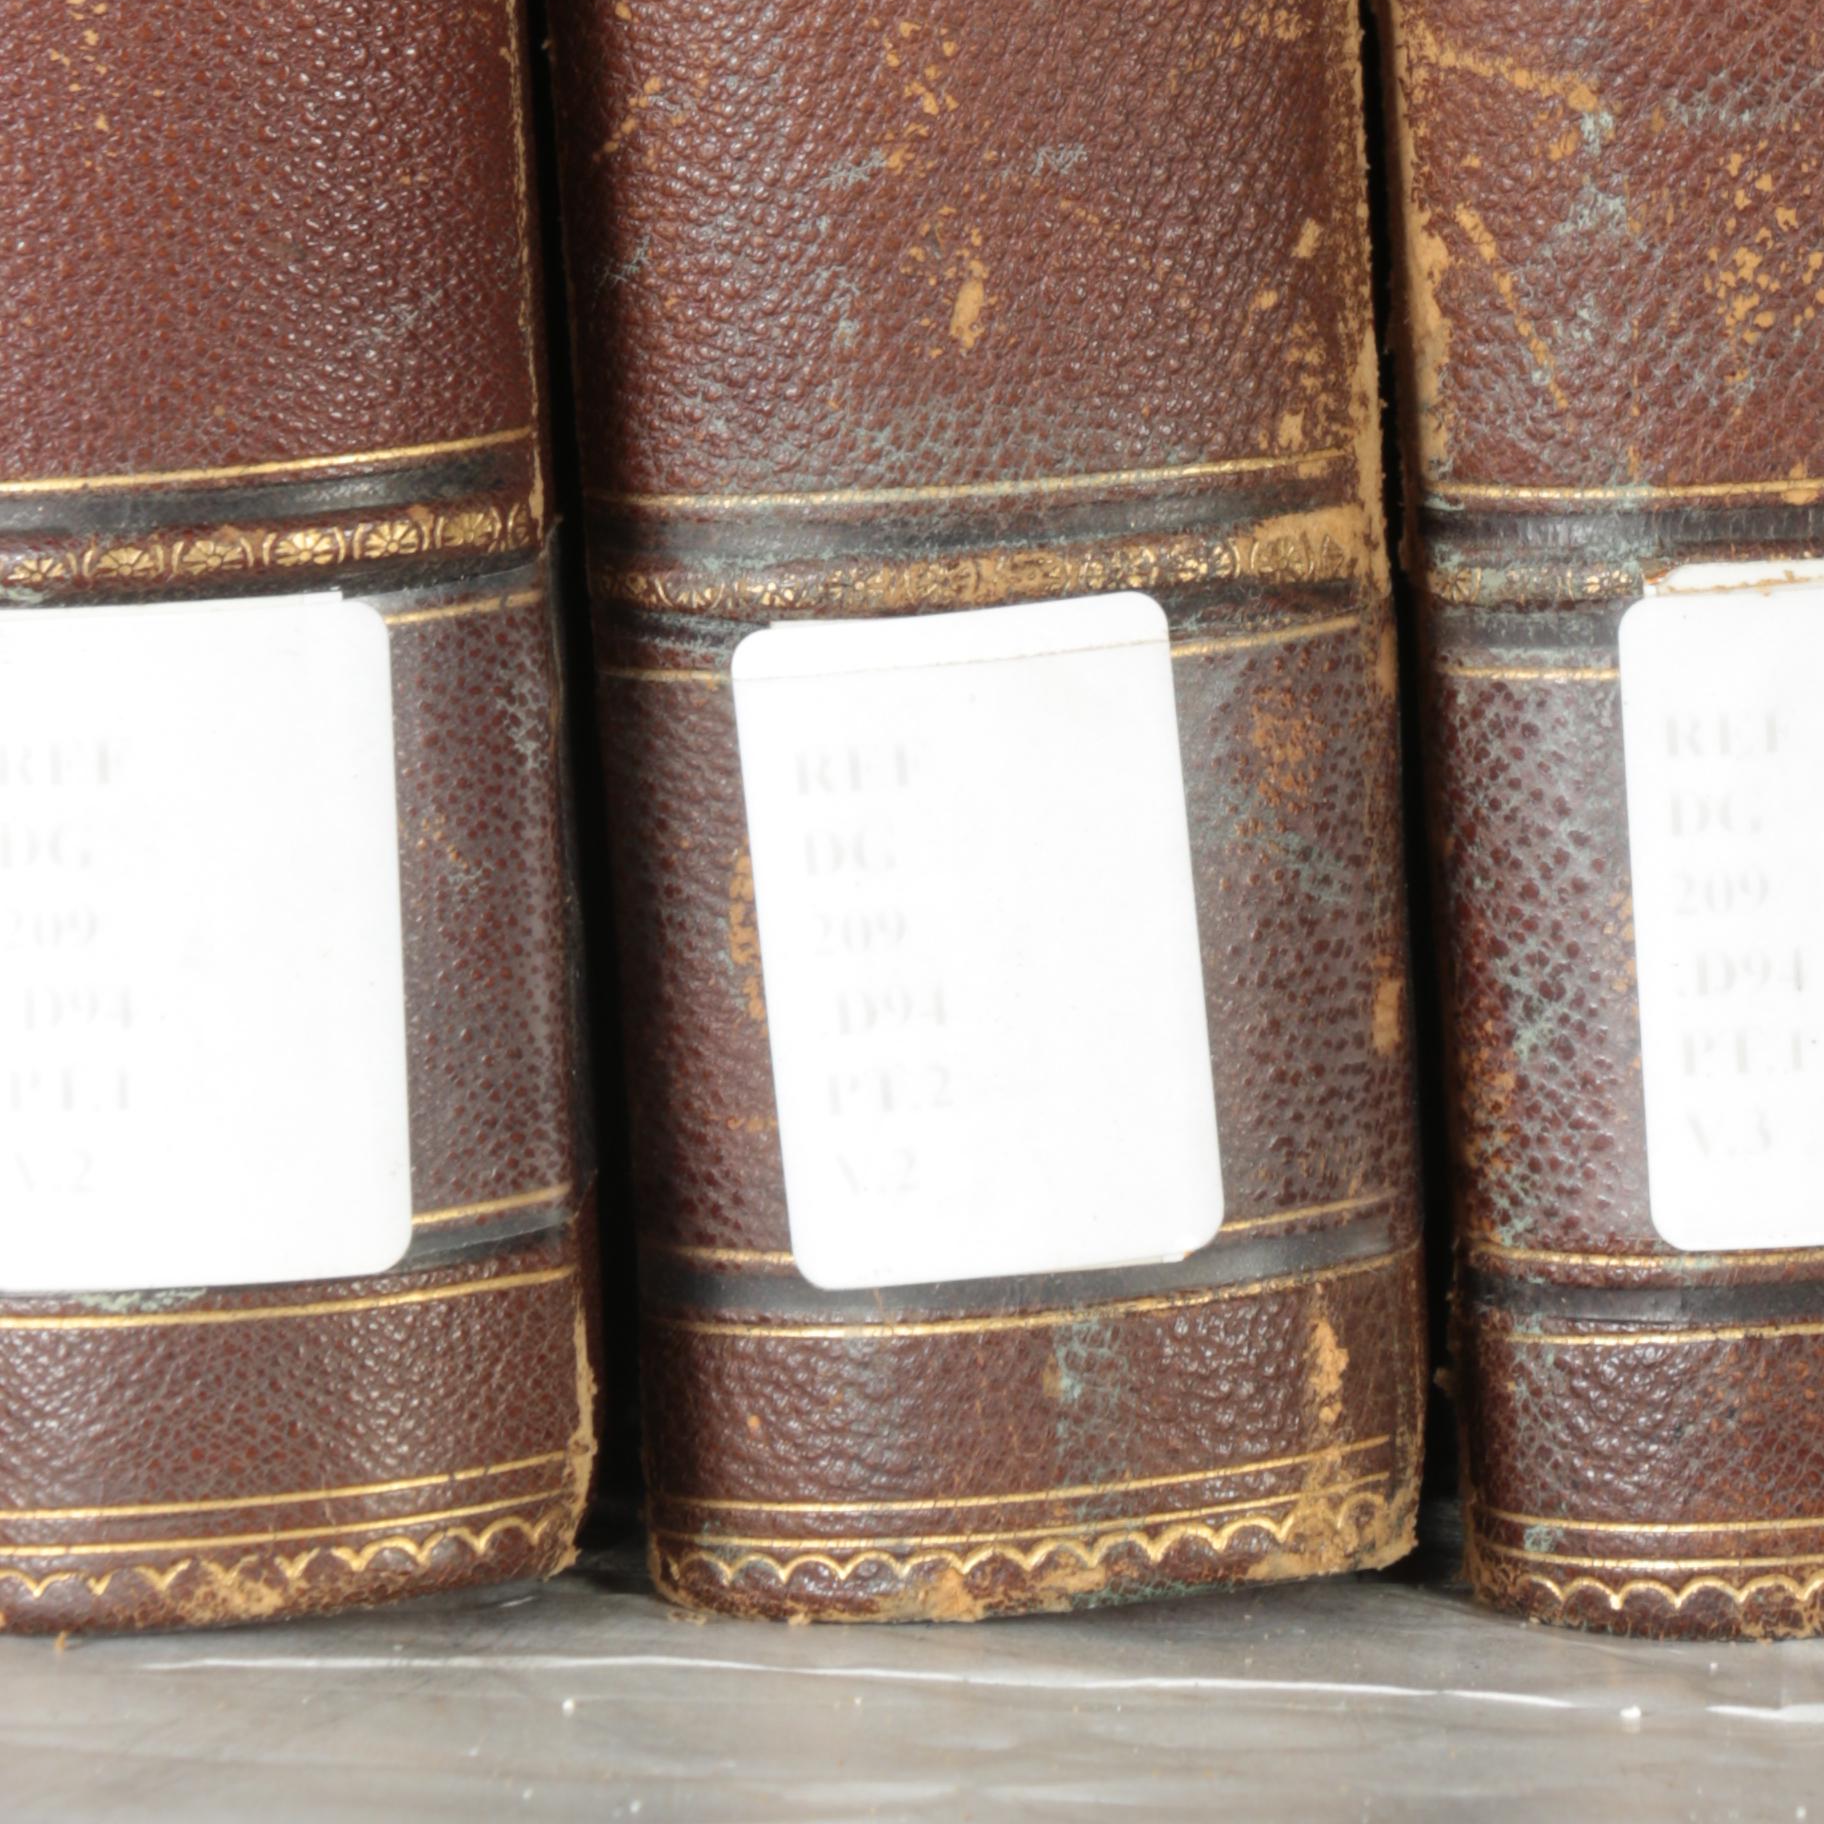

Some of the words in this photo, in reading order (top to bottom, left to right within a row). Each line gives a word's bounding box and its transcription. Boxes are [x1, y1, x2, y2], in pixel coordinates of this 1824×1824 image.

[1669, 788, 1763, 839] DG
[805, 824, 897, 878] DG
[1674, 868, 1770, 917] 209
[814, 906, 909, 959] 209
